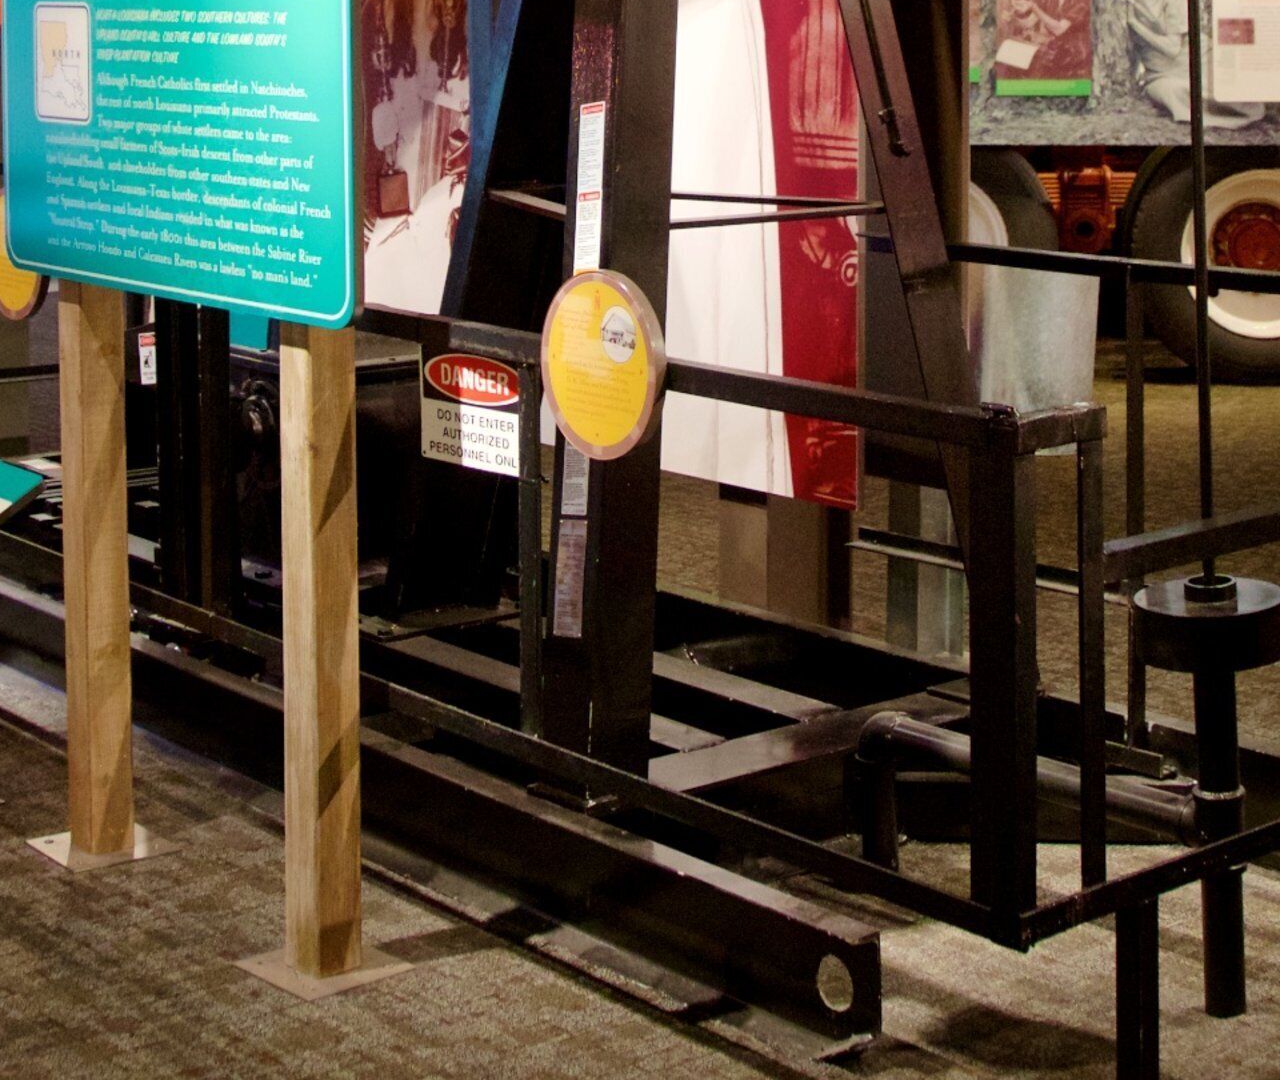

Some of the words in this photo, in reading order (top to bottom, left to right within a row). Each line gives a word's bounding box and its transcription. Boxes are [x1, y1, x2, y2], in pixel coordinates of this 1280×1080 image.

[181, 11, 196, 21] TWO
[198, 12, 232, 22] SOUTHERN
[273, 13, 287, 24] THE
[163, 31, 190, 42] CULTURE
[192, 32, 205, 43] AND
[207, 33, 219, 43] THE
[131, 75, 155, 87] French
[158, 77, 193, 90] Catholics
[195, 79, 210, 91] first
[212, 80, 238, 93] settled
[240, 81, 247, 93] in
[124, 95, 131, 107] of
[133, 96, 153, 108] north
[156, 98, 192, 111] Louisiana
[194, 100, 229, 119] primarily
[232, 103, 266, 117] attracted
[113, 120, 134, 132] major
[136, 122, 161, 136] groups
[162, 121, 171, 132] of
[173, 121, 192, 134] white
[194, 123, 221, 136] settlers
[223, 130, 243, 139] came
[246, 127, 254, 139] to
[256, 128, 269, 141] the
[149, 140, 157, 152] of
[159, 141, 200, 157] Scots-Irish
[202, 145, 230, 160] descent
[233, 148, 253, 162] from
[255, 151, 278, 165] other
[280, 158, 302, 172] parts
[304, 155, 314, 168] of
[109, 158, 121, 170] and
[123, 159, 166, 175] slaveholders
[168, 164, 186, 178] from
[189, 166, 209, 180] other
[211, 169, 247, 185] southern
[249, 173, 271, 187] states
[272, 176, 288, 189] and
[291, 178, 311, 192] New
[78, 176, 97, 193] Along
[100, 178, 109, 190] the
[112, 180, 170, 198] Louisiana-Texas
[202, 191, 251, 208] descendants
[252, 197, 262, 210] of
[263, 198, 297, 214] colonial
[300, 202, 331, 218] French
[113, 201, 125, 214] and
[145, 206, 173, 220] Indians
[176, 210, 202, 224] resided
[204, 214, 213, 226] in
[215, 215, 232, 229] what
[235, 222, 248, 231] was
[251, 220, 277, 235] known
[280, 228, 288, 236] as
[290, 225, 304, 239] the
[61, 235, 71, 247] the
[124, 245, 136, 258] and
[174, 253, 197, 268] Rivers
[199, 262, 212, 271] was
[220, 260, 245, 276] lawless
[101, 220, 126, 239] During
[128, 224, 140, 237] the
[141, 226, 158, 244] early
[185, 232, 198, 246] this
[200, 239, 216, 248] area
[219, 237, 250, 254] between
[252, 242, 265, 256] the
[268, 244, 296, 261] Sabine
[298, 249, 322, 264] River
[440, 363, 510, 395] DANGER
[437, 409, 452, 422] DO
[454, 412, 475, 425] NOT
[479, 416, 514, 433] ENTER
[442, 426, 510, 449] AUTHORIZED
[429, 441, 492, 464] PERSONNEL
[495, 454, 517, 468] ONL
